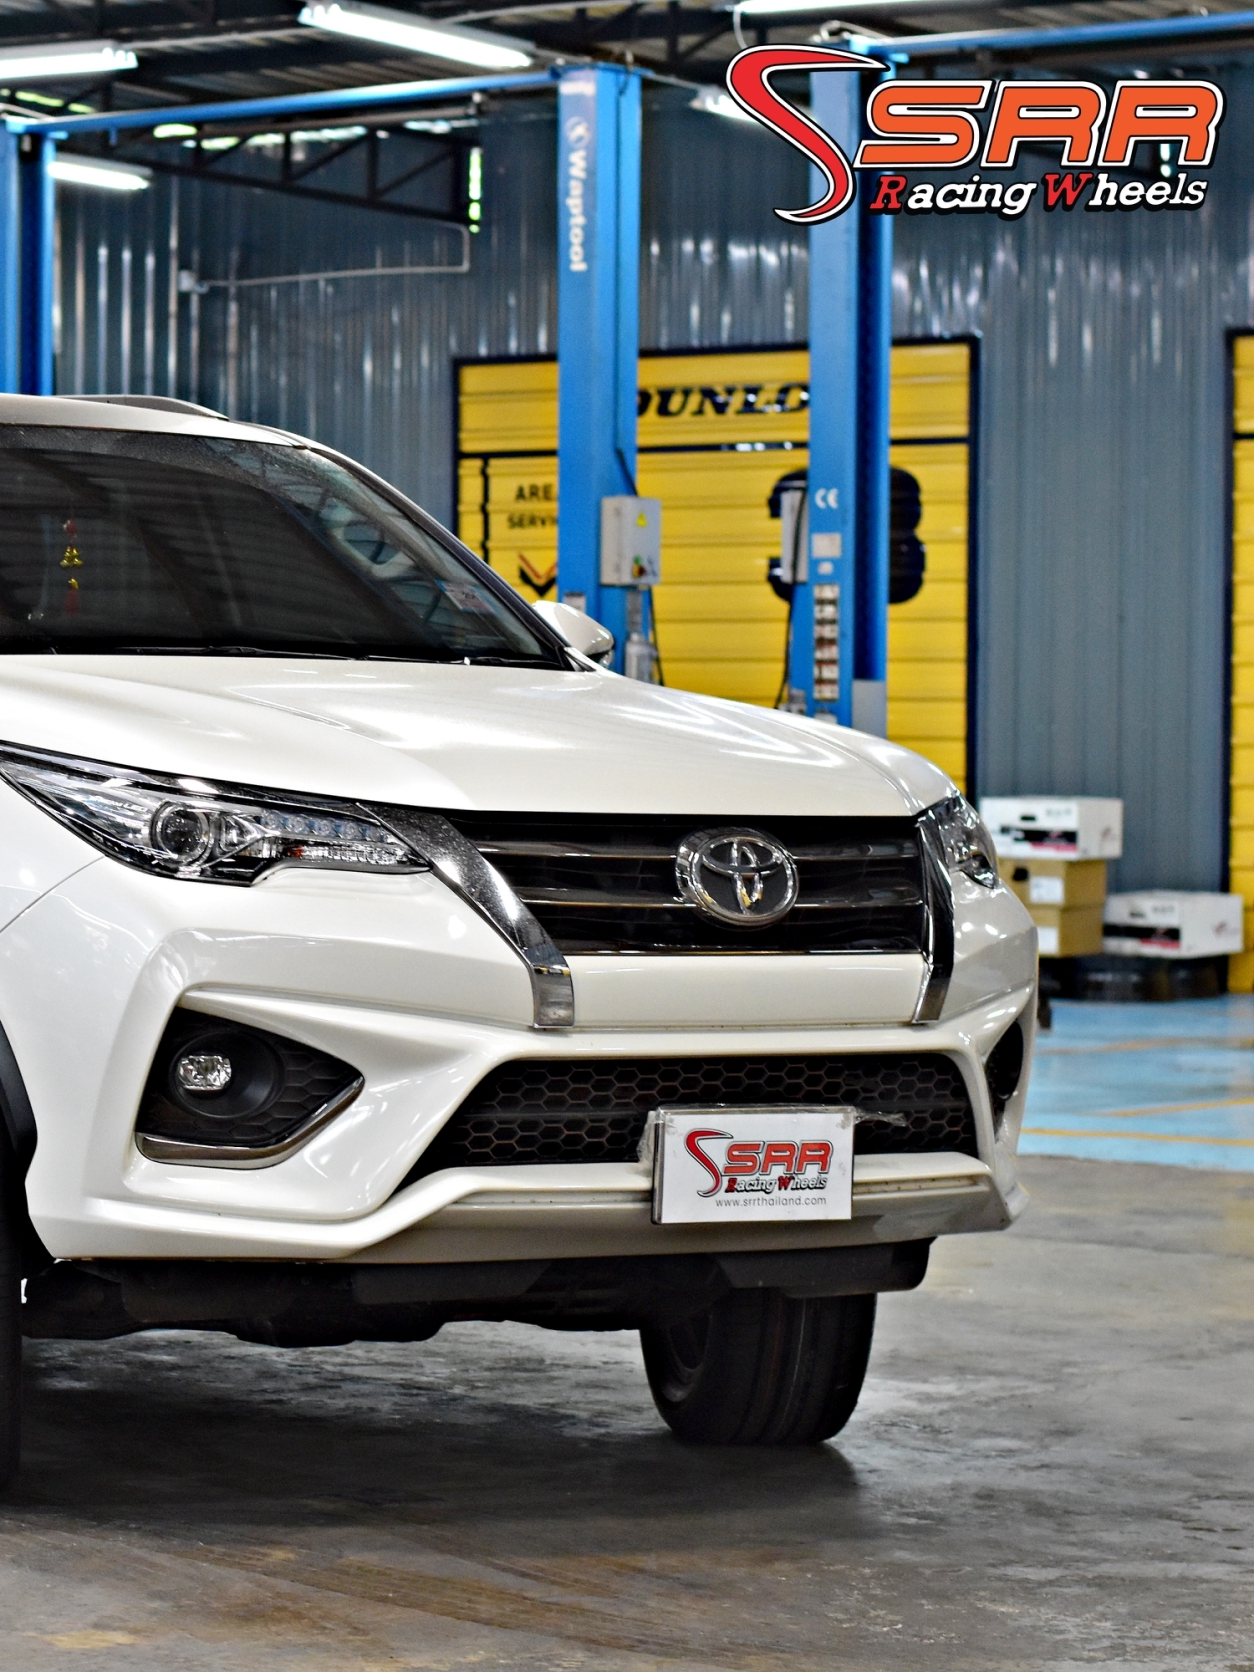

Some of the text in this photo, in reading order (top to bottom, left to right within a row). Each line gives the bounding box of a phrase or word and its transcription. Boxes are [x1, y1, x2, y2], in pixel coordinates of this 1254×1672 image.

[566, 149, 588, 272] Waptool
[725, 1175, 828, 1194] Racing Wheels
[715, 1196, 827, 1207] www.srrthailand.com
